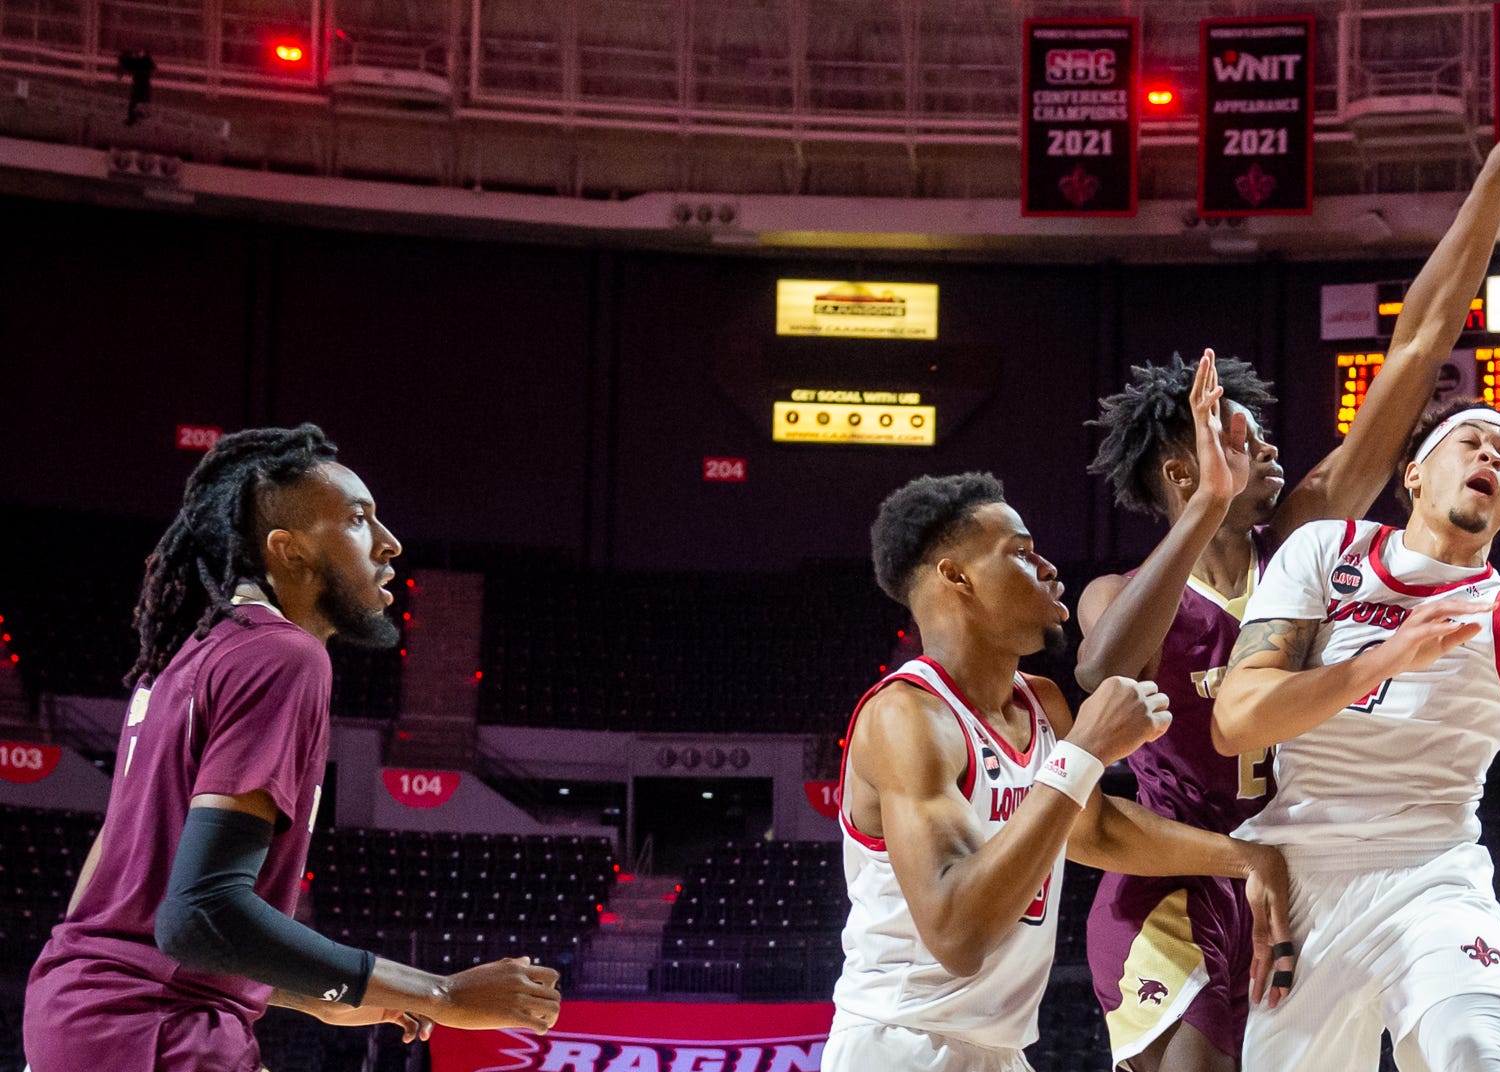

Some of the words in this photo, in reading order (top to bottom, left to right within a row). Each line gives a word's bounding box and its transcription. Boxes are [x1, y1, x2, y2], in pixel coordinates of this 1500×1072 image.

[1045, 48, 1116, 85] SBC
[1213, 52, 1302, 82] WNIT
[1047, 130, 1112, 156] 2021
[1223, 128, 1288, 156] 2021
[706, 460, 744, 478] 204
[1333, 572, 1360, 587] LOVE
[0, 746, 43, 770] 103
[401, 774, 442, 796] 104
